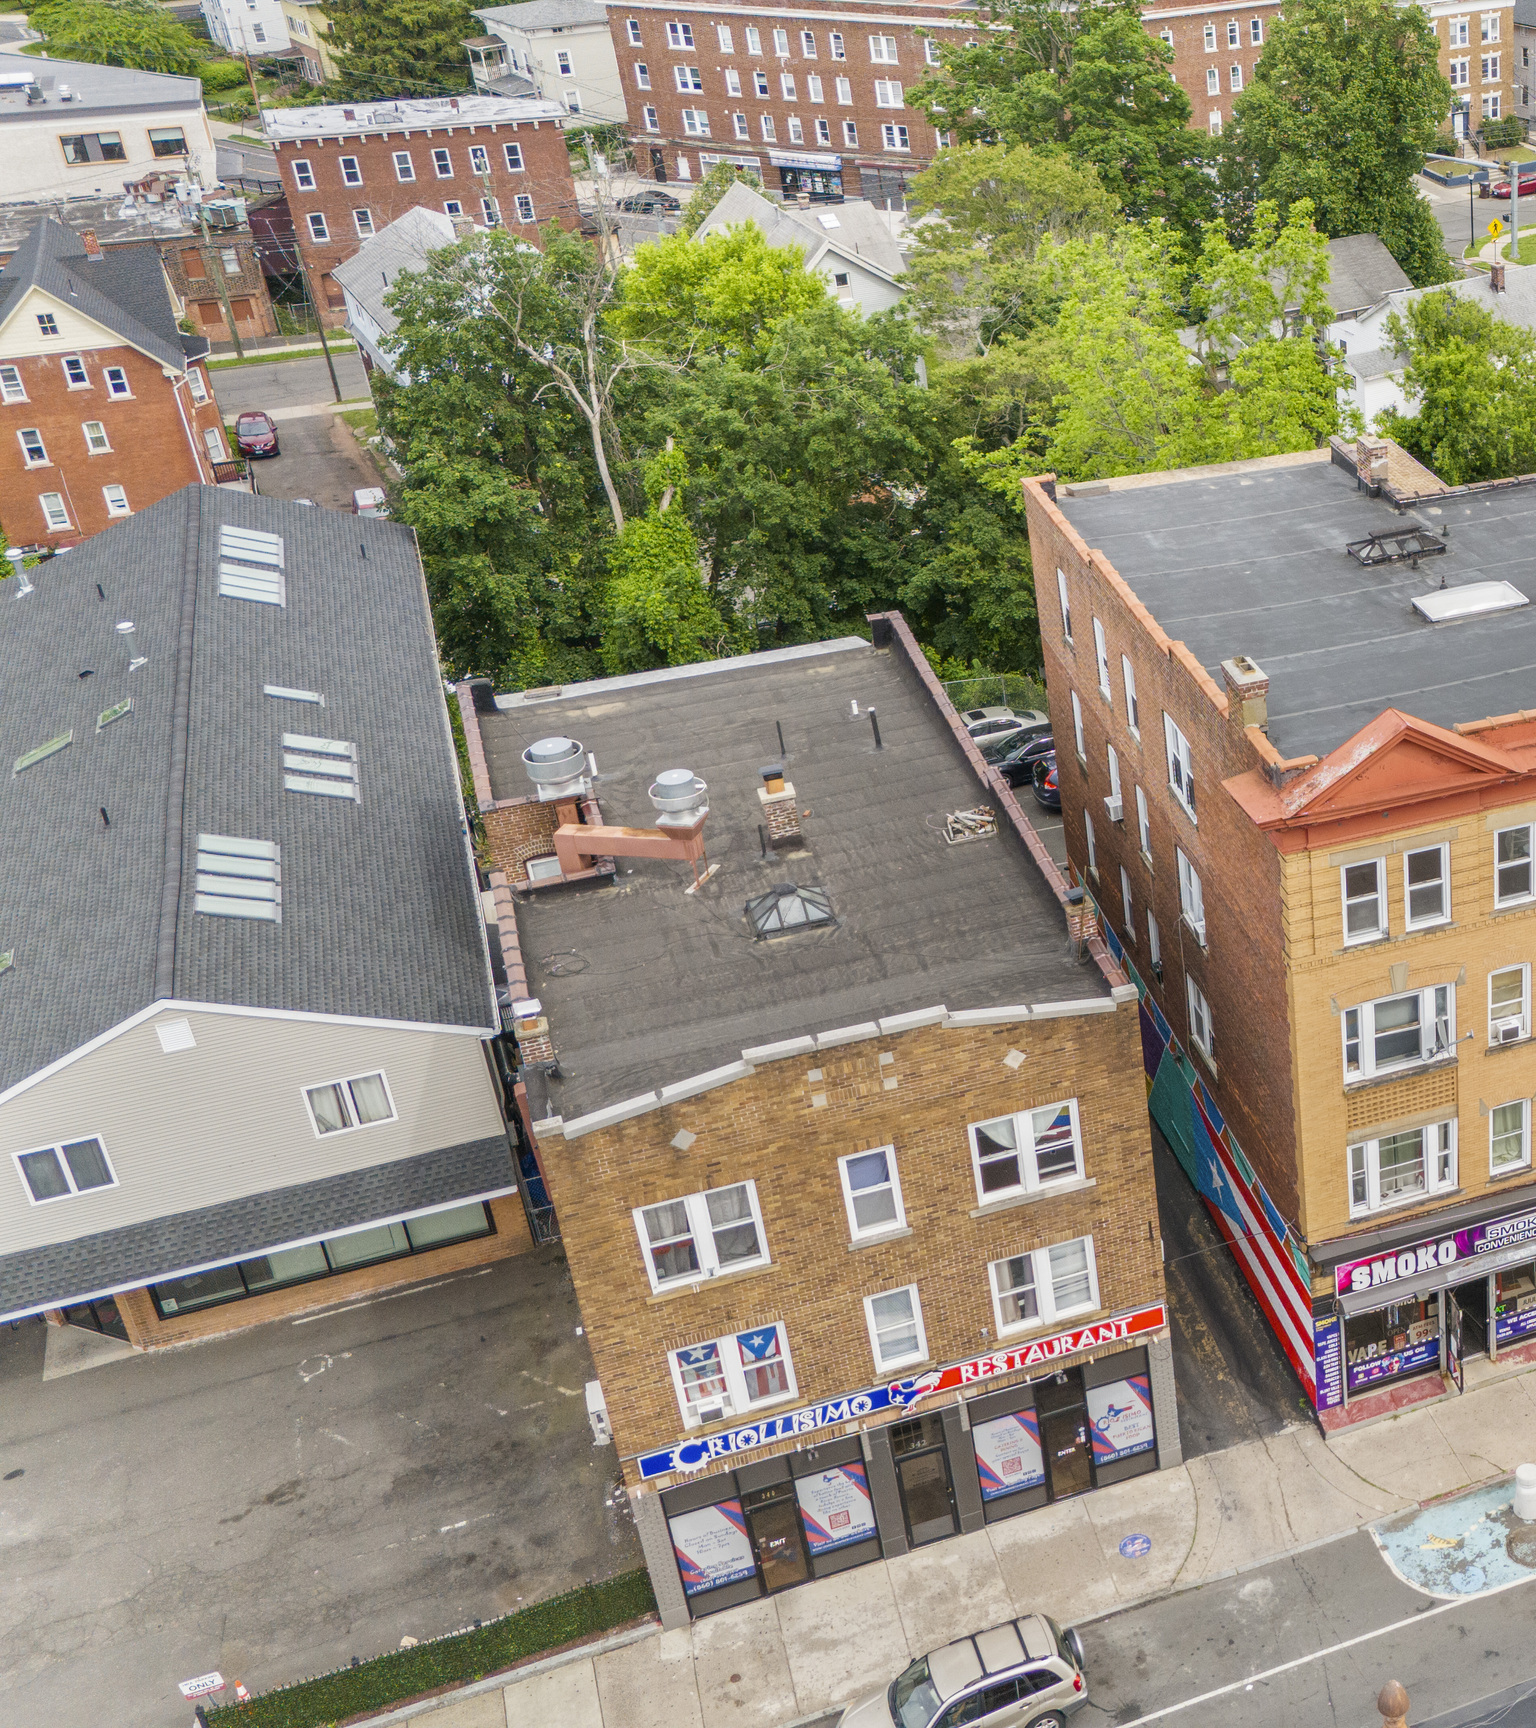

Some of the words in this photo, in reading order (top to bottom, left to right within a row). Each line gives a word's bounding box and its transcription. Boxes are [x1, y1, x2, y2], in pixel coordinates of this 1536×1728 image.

[1351, 1239, 1458, 1291] SMOKO
[1506, 1316, 1518, 1324] WE
[960, 1317, 1133, 1383] RESTAURANT
[1347, 1340, 1388, 1363] VAPE
[1353, 1360, 1382, 1373] FOLLOW
[1403, 1349, 1413, 1357] US
[669, 1395, 873, 1475] CRIOLLISIMO
[1057, 1447, 1076, 1457] ENTER
[769, 1537, 786, 1548] EXIT
[189, 1679, 215, 1691] ONLY
